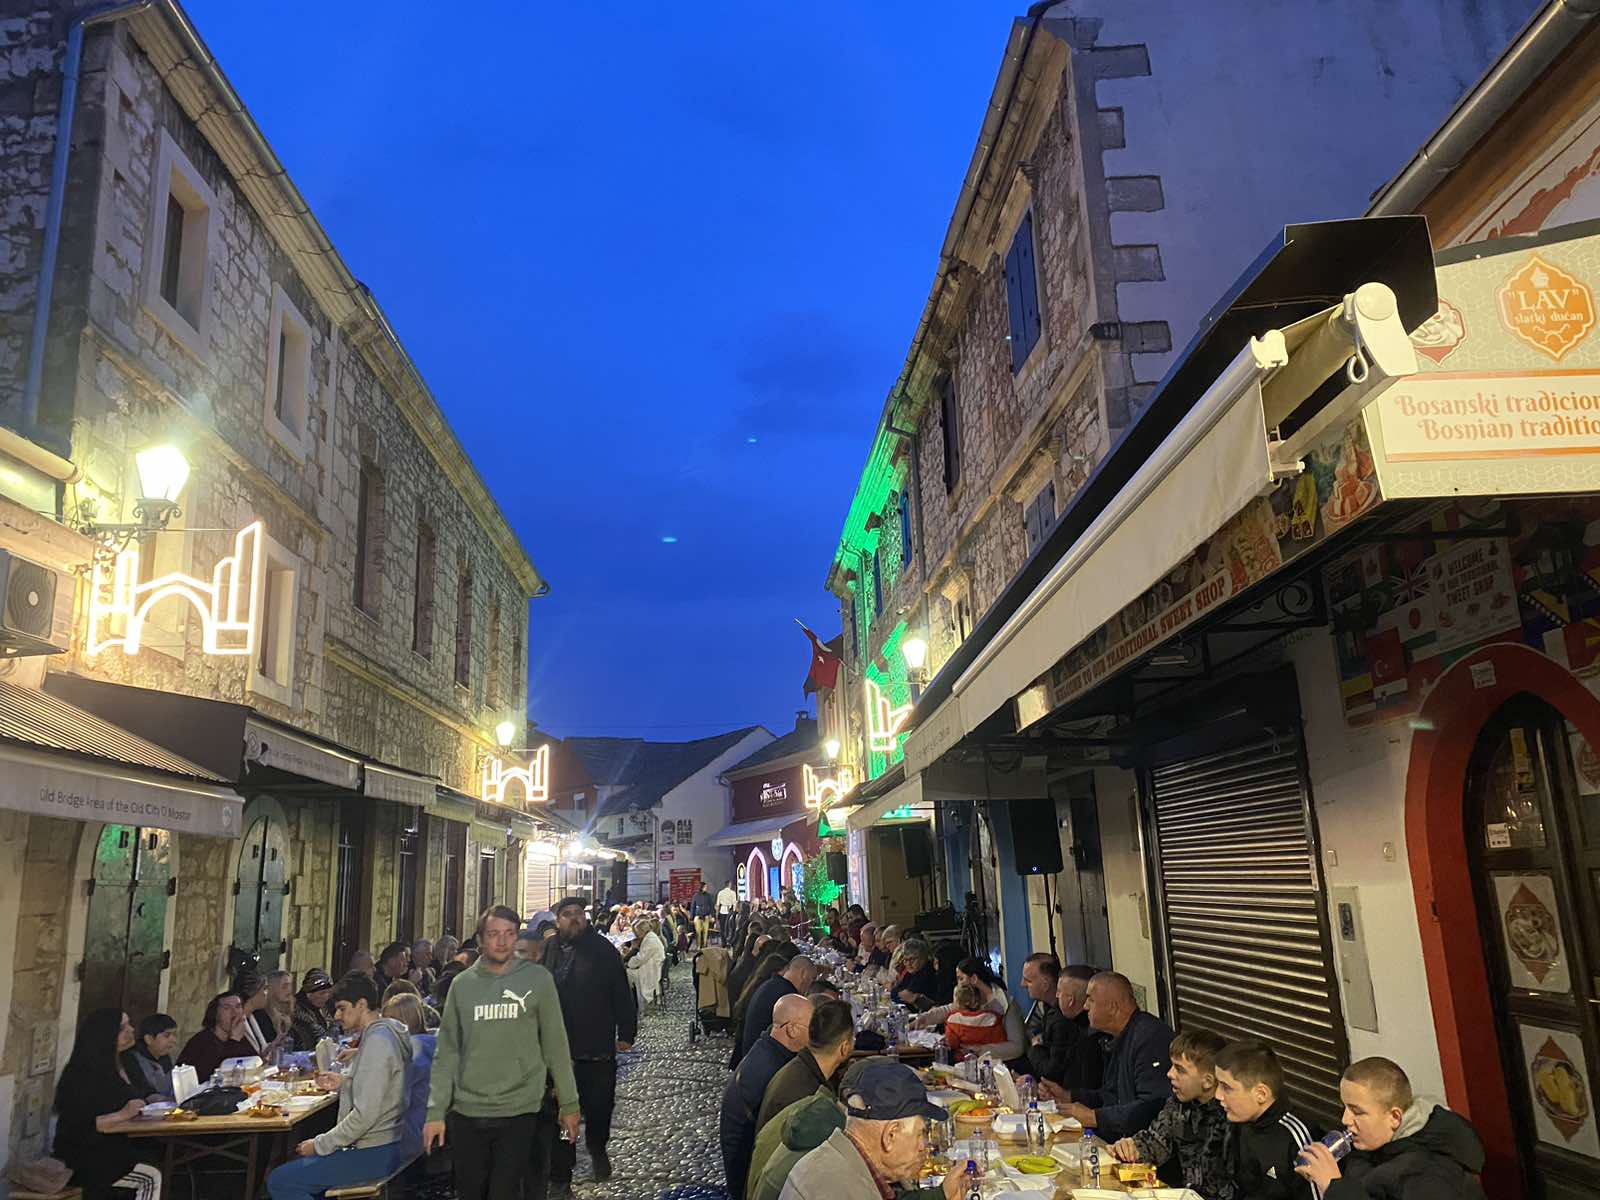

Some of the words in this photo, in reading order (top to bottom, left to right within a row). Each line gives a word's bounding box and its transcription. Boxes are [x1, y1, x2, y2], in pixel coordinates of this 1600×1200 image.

[1394, 392, 1500, 417] Bosanski
[1418, 418, 1514, 441] Bosnian
[1106, 624, 1160, 669] TRADITIONAL
[1161, 600, 1194, 634] SWEET
[1195, 575, 1226, 610] SHOP
[40, 788, 55, 803] Old
[57, 791, 84, 808] Bridge
[115, 800, 129, 813] the
[130, 802, 144, 815] Old
[473, 1003, 519, 1021] PUMA
